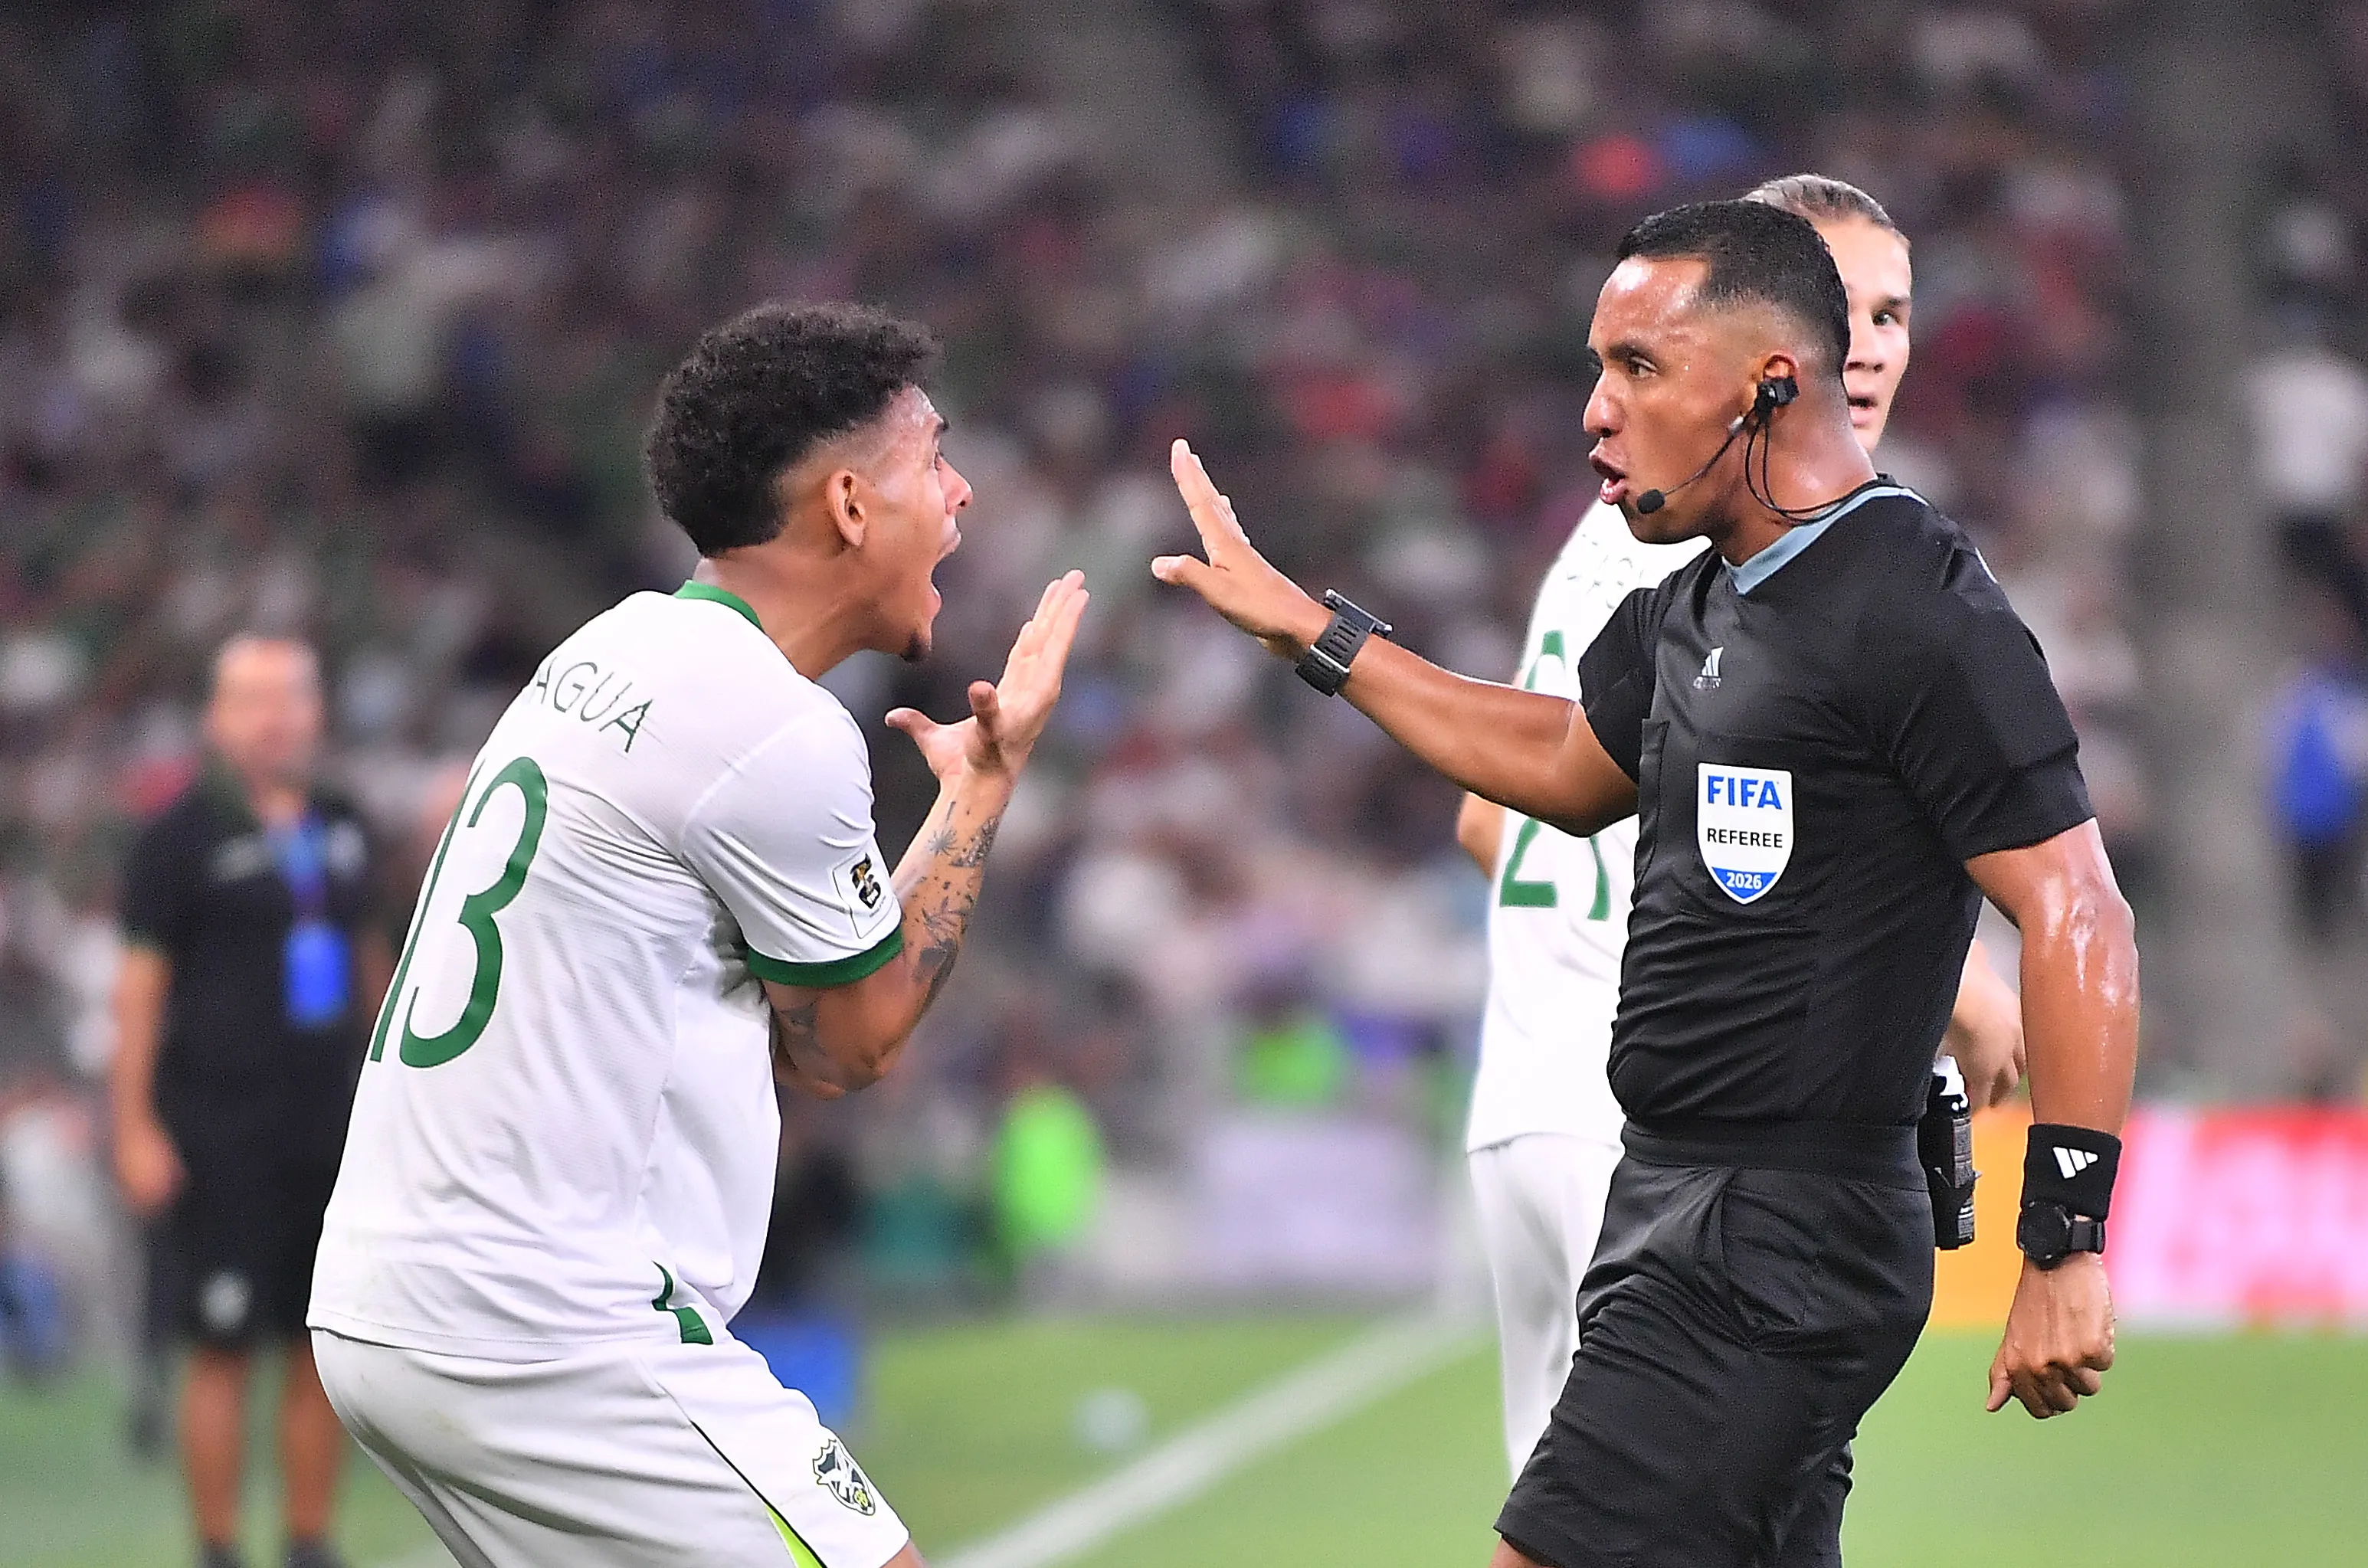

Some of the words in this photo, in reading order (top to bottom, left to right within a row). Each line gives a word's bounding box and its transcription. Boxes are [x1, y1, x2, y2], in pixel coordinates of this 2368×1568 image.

[1707, 774, 1783, 810] FIFA
[1707, 827, 1783, 849] REFEREE
[1726, 872, 1763, 890] 2026
[370, 755, 548, 1069] 13
